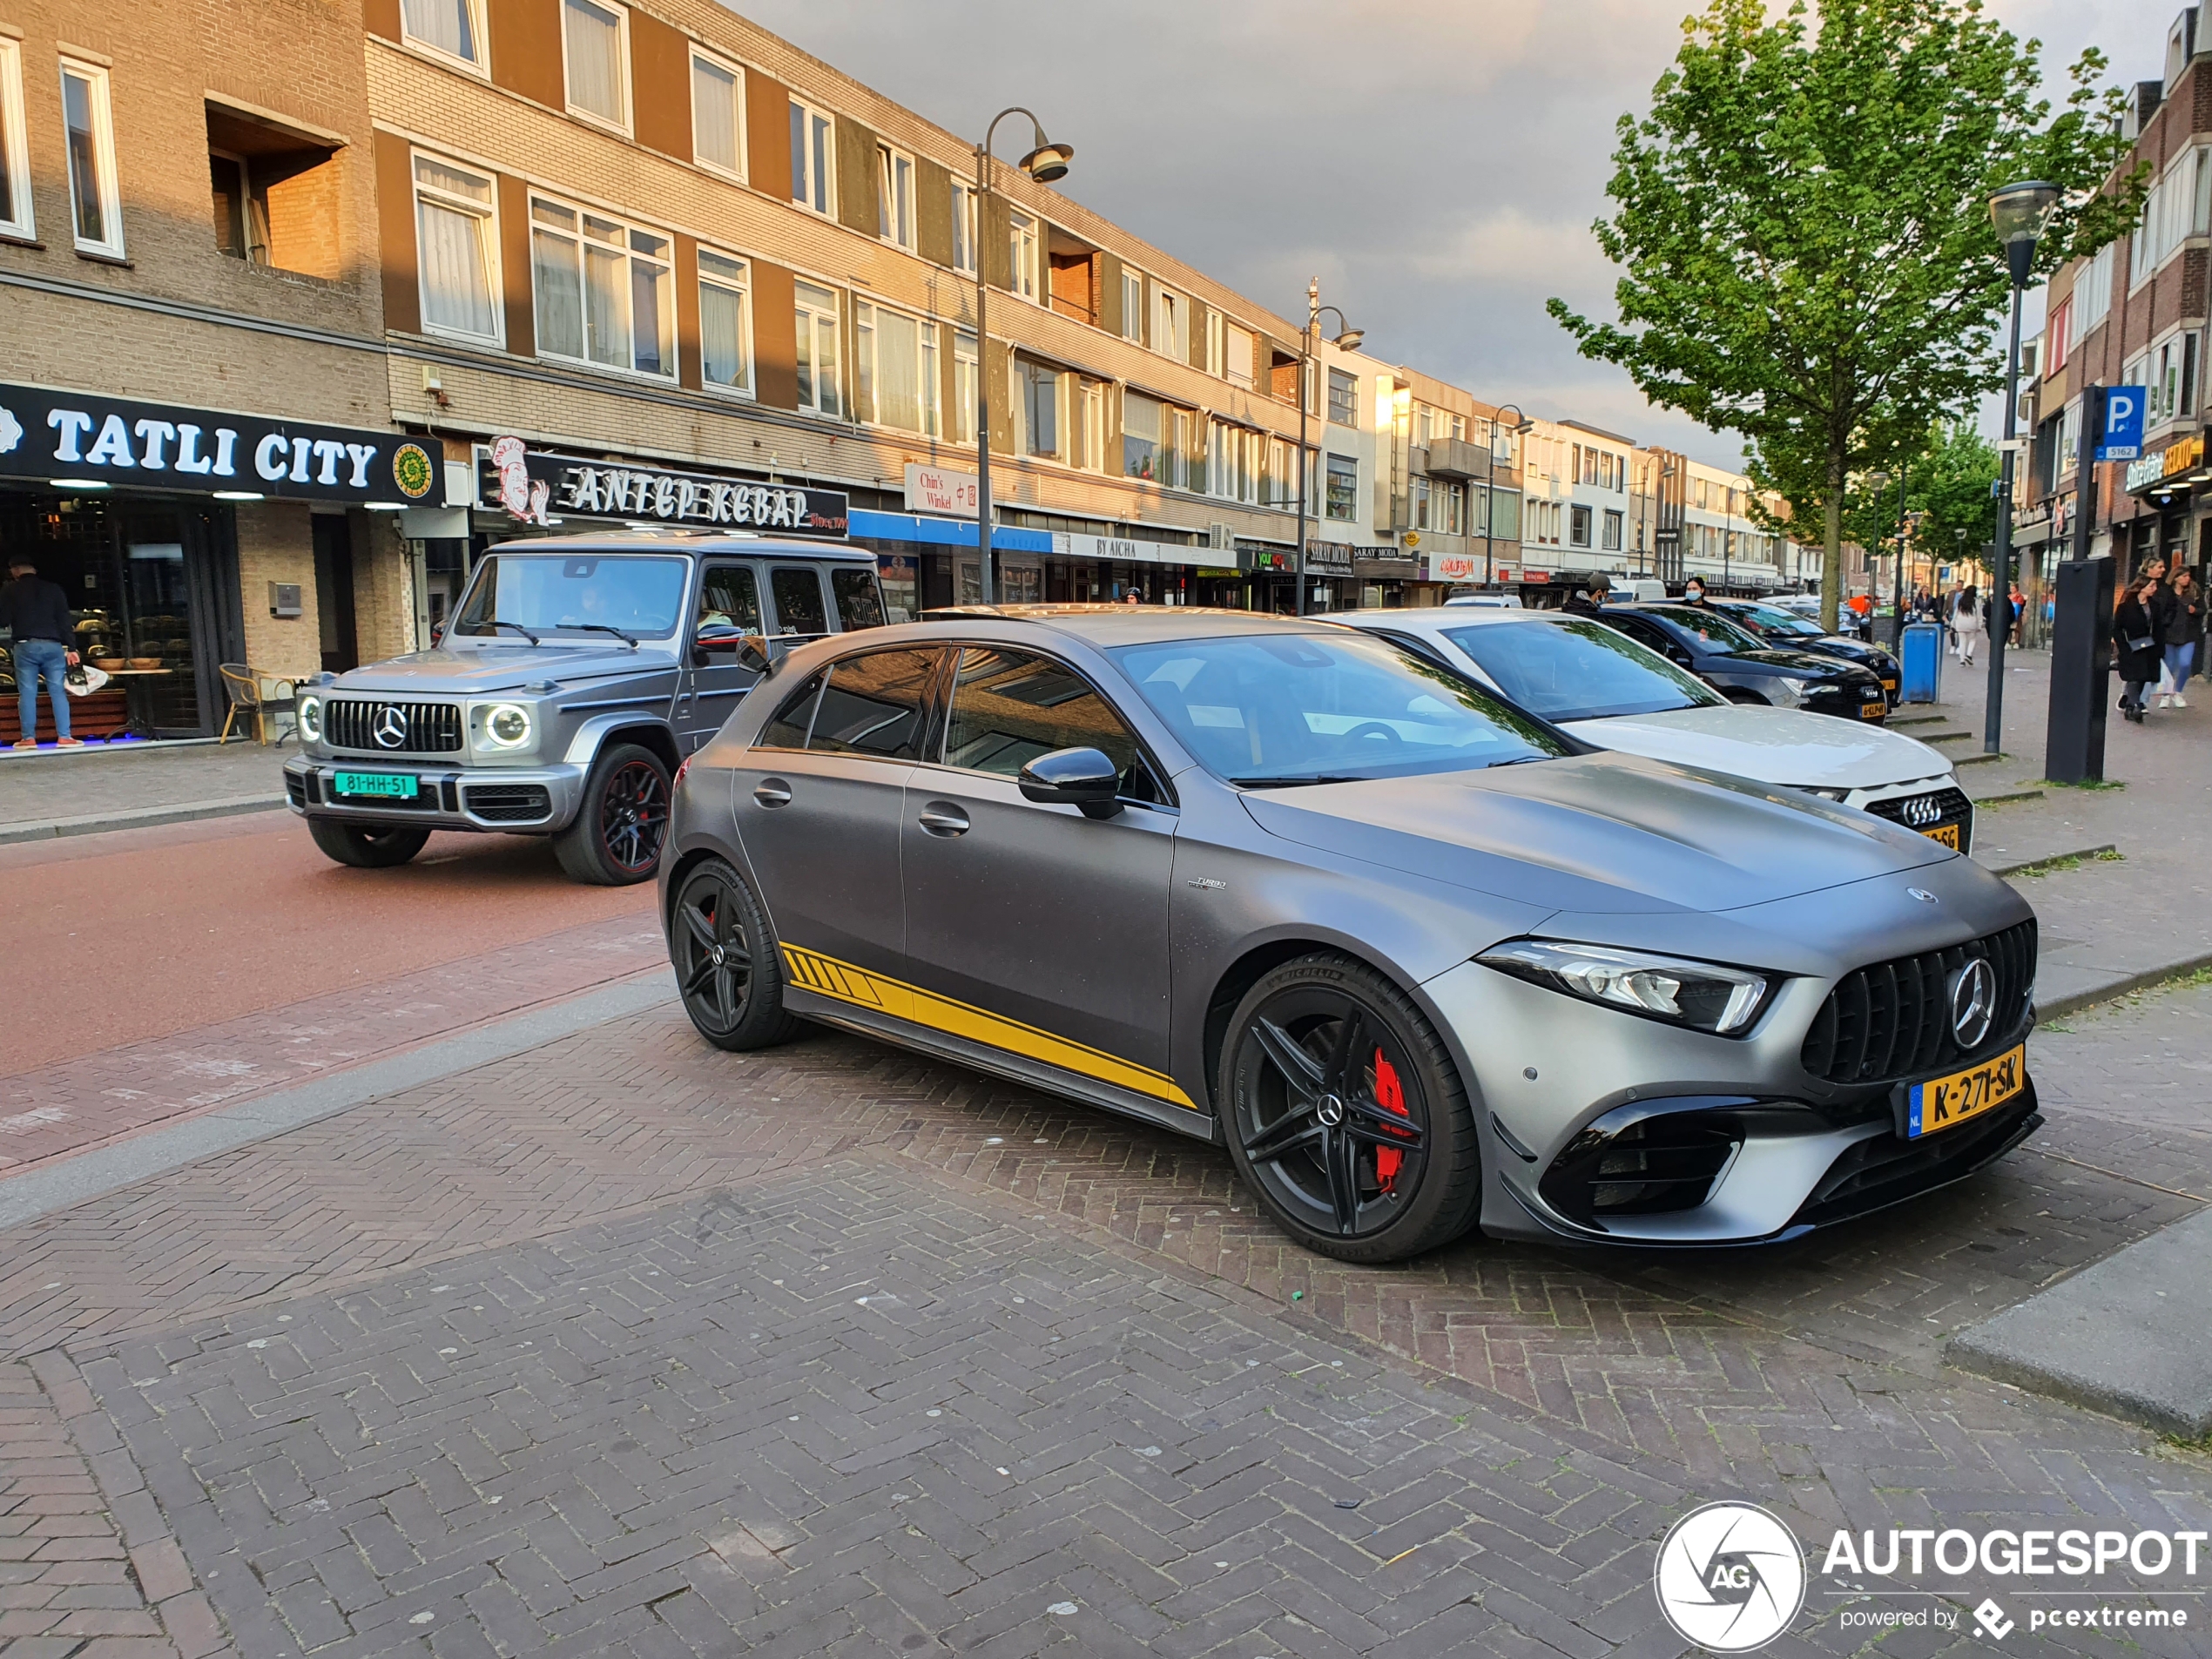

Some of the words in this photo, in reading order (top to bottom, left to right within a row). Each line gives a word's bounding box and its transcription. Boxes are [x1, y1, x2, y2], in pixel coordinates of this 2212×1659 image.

[2107, 396, 2134, 433] P
[47, 408, 238, 475] TATLI
[254, 433, 377, 488] CITY
[2111, 448, 2132, 456] 5162
[2163, 436, 2194, 477] GELATO
[920, 472, 943, 490] Chin's
[574, 467, 695, 520] ANTEP
[711, 482, 808, 529] KEBAP
[927, 491, 951, 509] Winkel
[1096, 538, 1107, 556] BY
[1109, 540, 1136, 558] AICHA
[1311, 542, 1331, 563] SARAY
[1331, 545, 1351, 564] MODA
[1378, 548, 1397, 557] MODA
[347, 775, 407, 793] 81-HH-51
[1197, 876, 1226, 887] TURBO
[1910, 1115, 1921, 1128] NL
